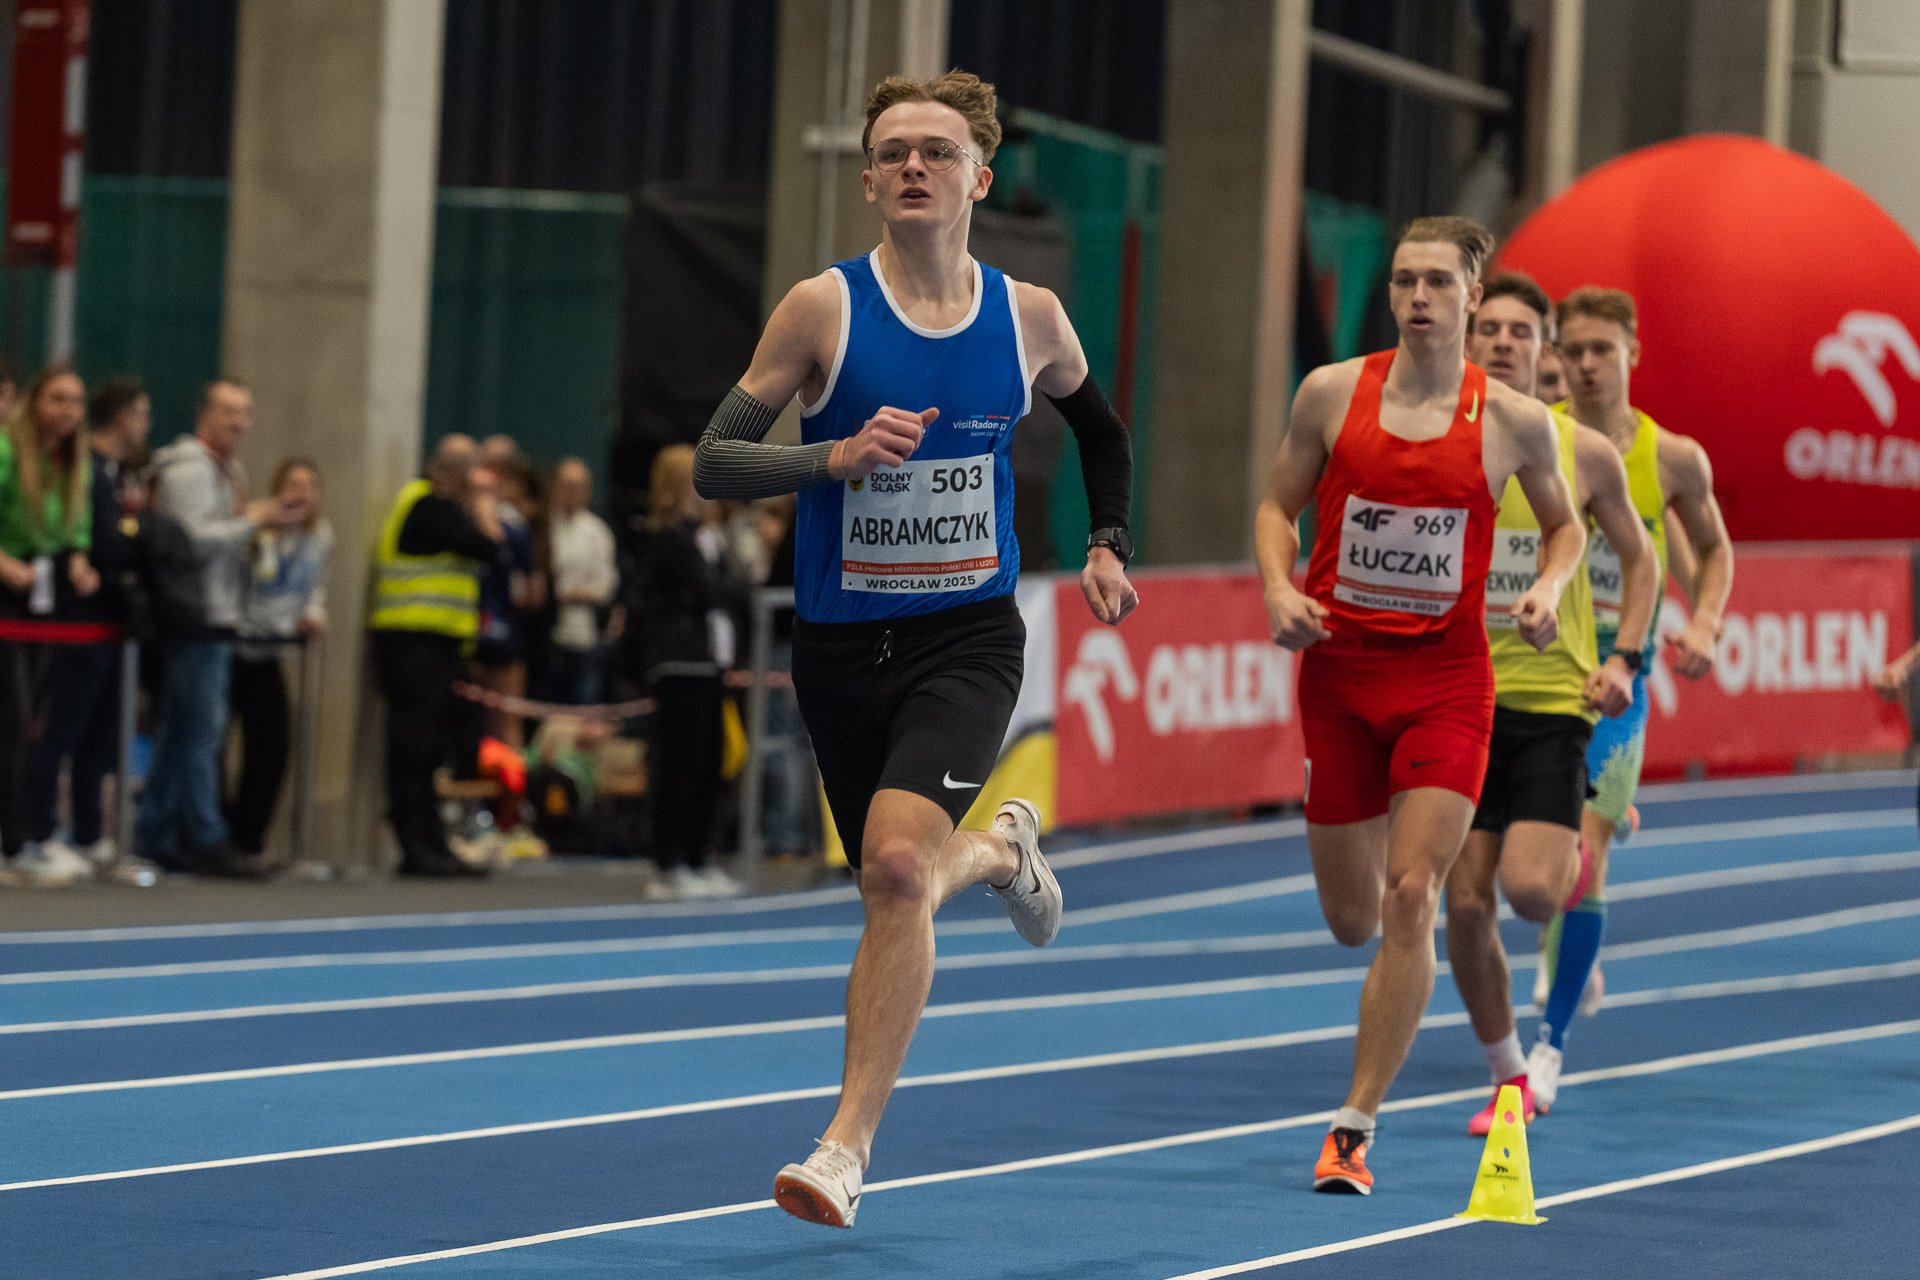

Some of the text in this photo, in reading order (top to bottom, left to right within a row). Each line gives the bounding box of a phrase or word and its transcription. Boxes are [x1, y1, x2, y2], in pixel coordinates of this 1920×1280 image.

[870, 472, 913, 482] DOLNY
[931, 465, 983, 494] 503
[849, 510, 990, 546] ABRAMCZYK
[1351, 506, 1397, 532] 4F
[1413, 515, 1456, 536] 969
[1508, 535, 1539, 556] 95
[846, 563, 863, 571] PZLA
[864, 565, 893, 573] Halowe
[894, 564, 940, 573] Mistrzostwa
[941, 562, 961, 572] Polski
[979, 558, 995, 567] U20
[1348, 542, 1452, 577] ŁUCZAK
[865, 574, 976, 590] WROCŁAW 2025
[1715, 611, 1888, 694] ORLEN
[1145, 641, 1292, 736] ORLEN
